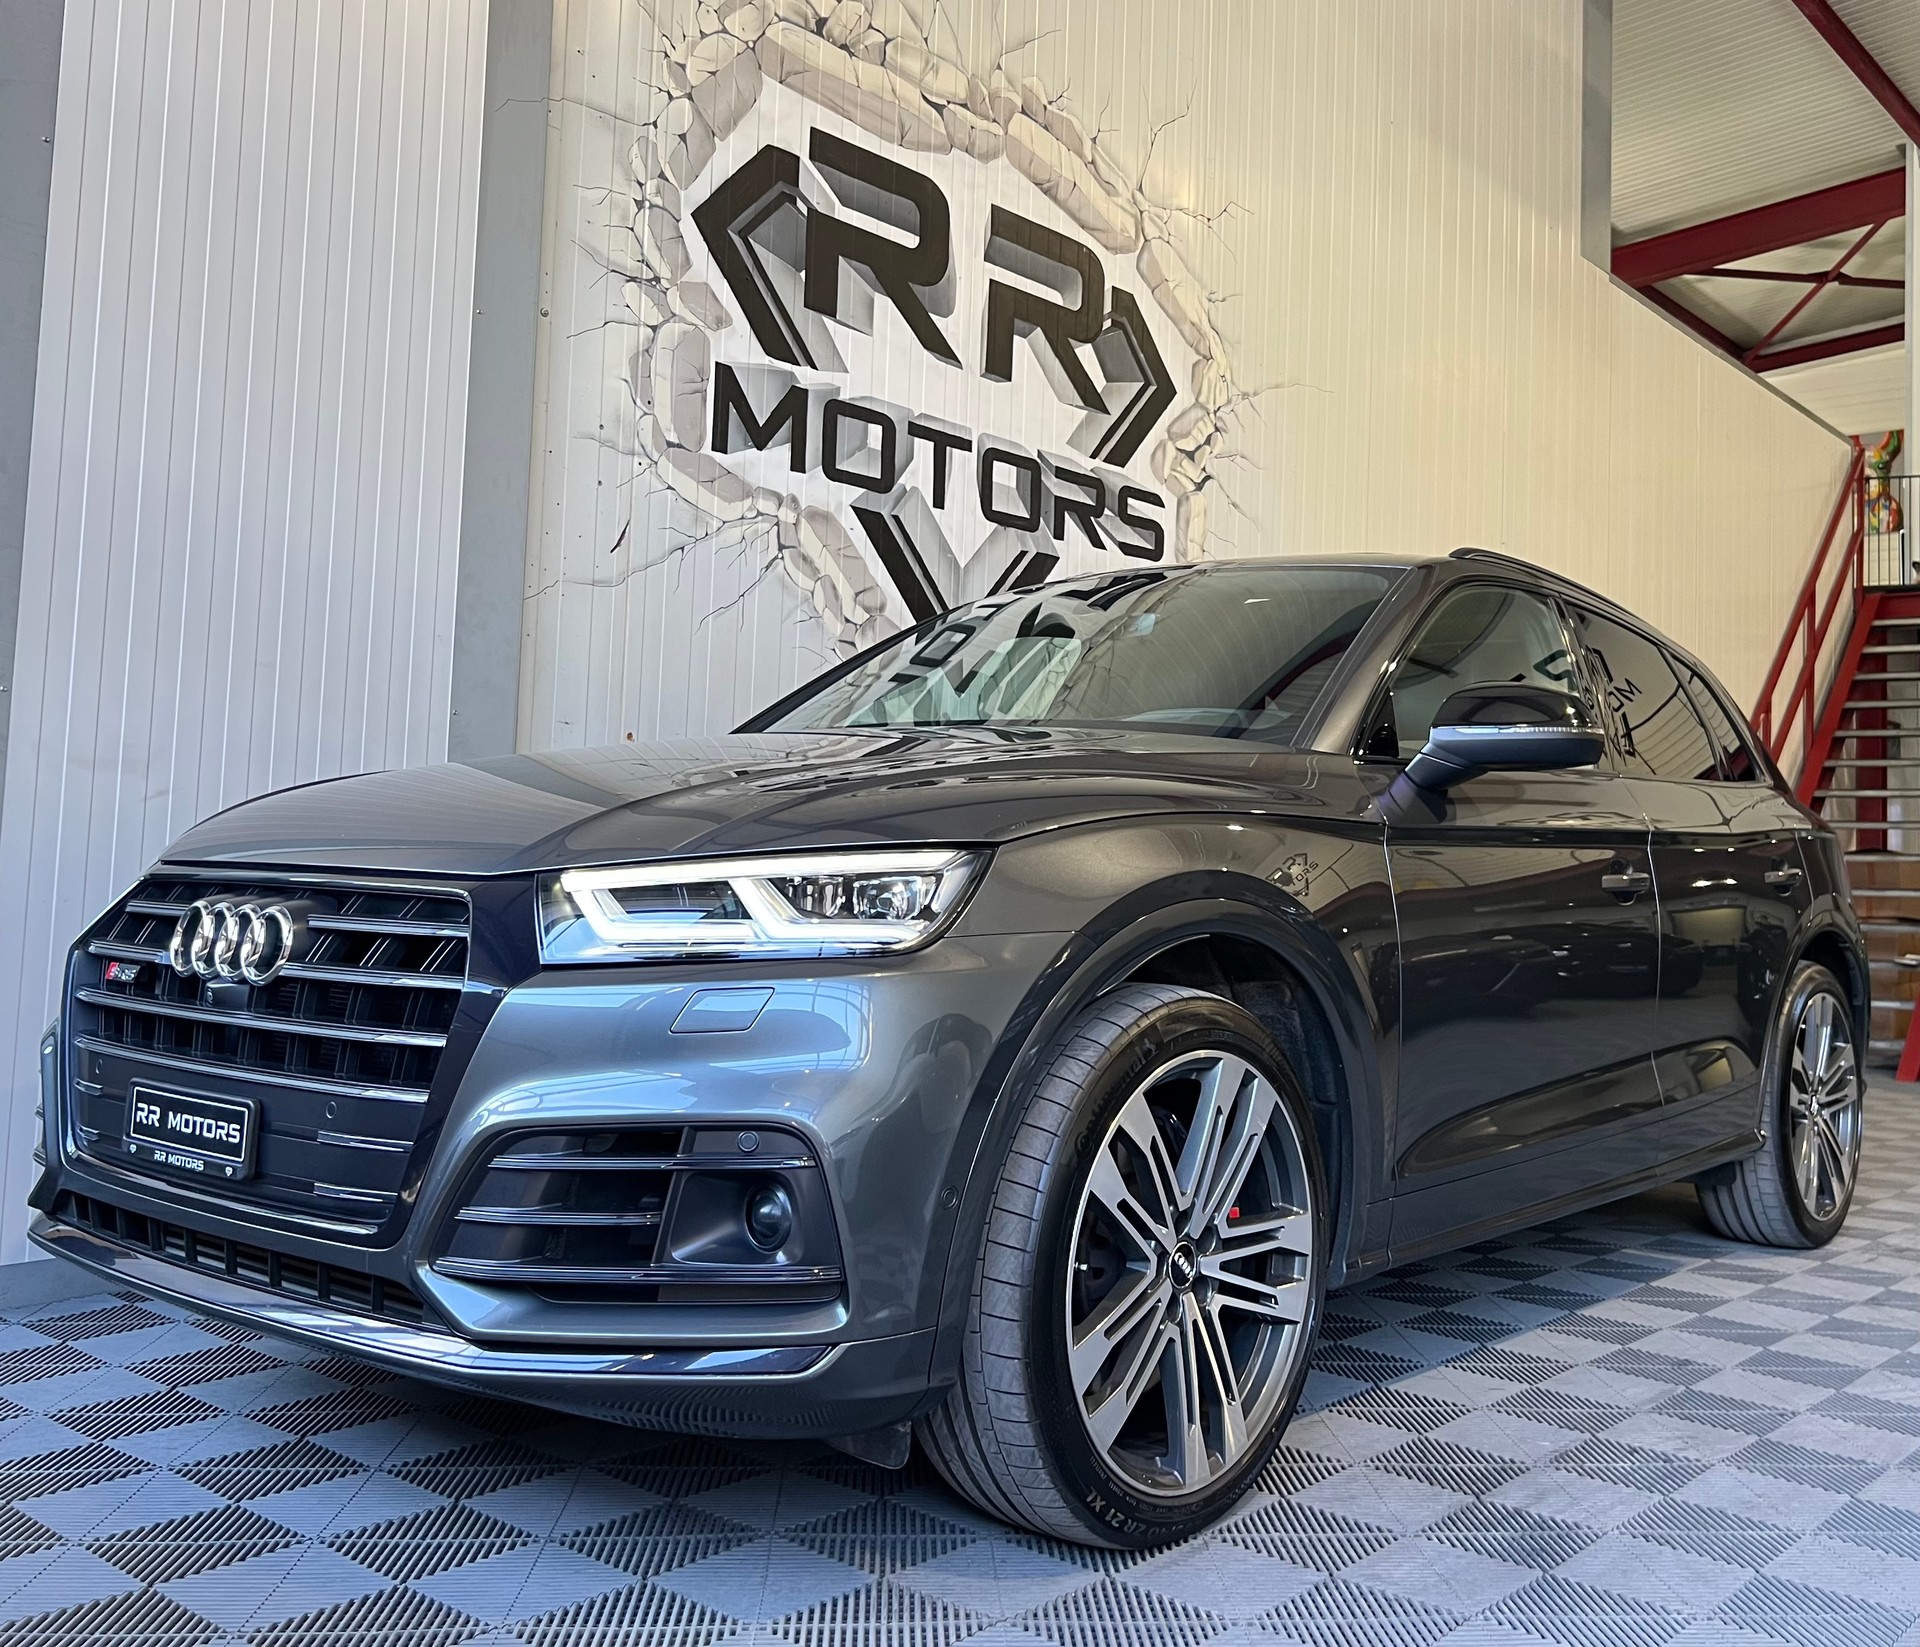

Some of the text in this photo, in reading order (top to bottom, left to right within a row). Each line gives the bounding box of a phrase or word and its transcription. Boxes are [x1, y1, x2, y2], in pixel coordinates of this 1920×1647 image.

[804, 126, 1111, 415] RR
[711, 361, 1166, 562] MOTORS
[136, 1102, 241, 1143] RR MOTORS
[153, 1150, 205, 1171] RR MOTORS
[1086, 1486, 1106, 1511] XL
[1104, 1508, 1126, 1527] 21
